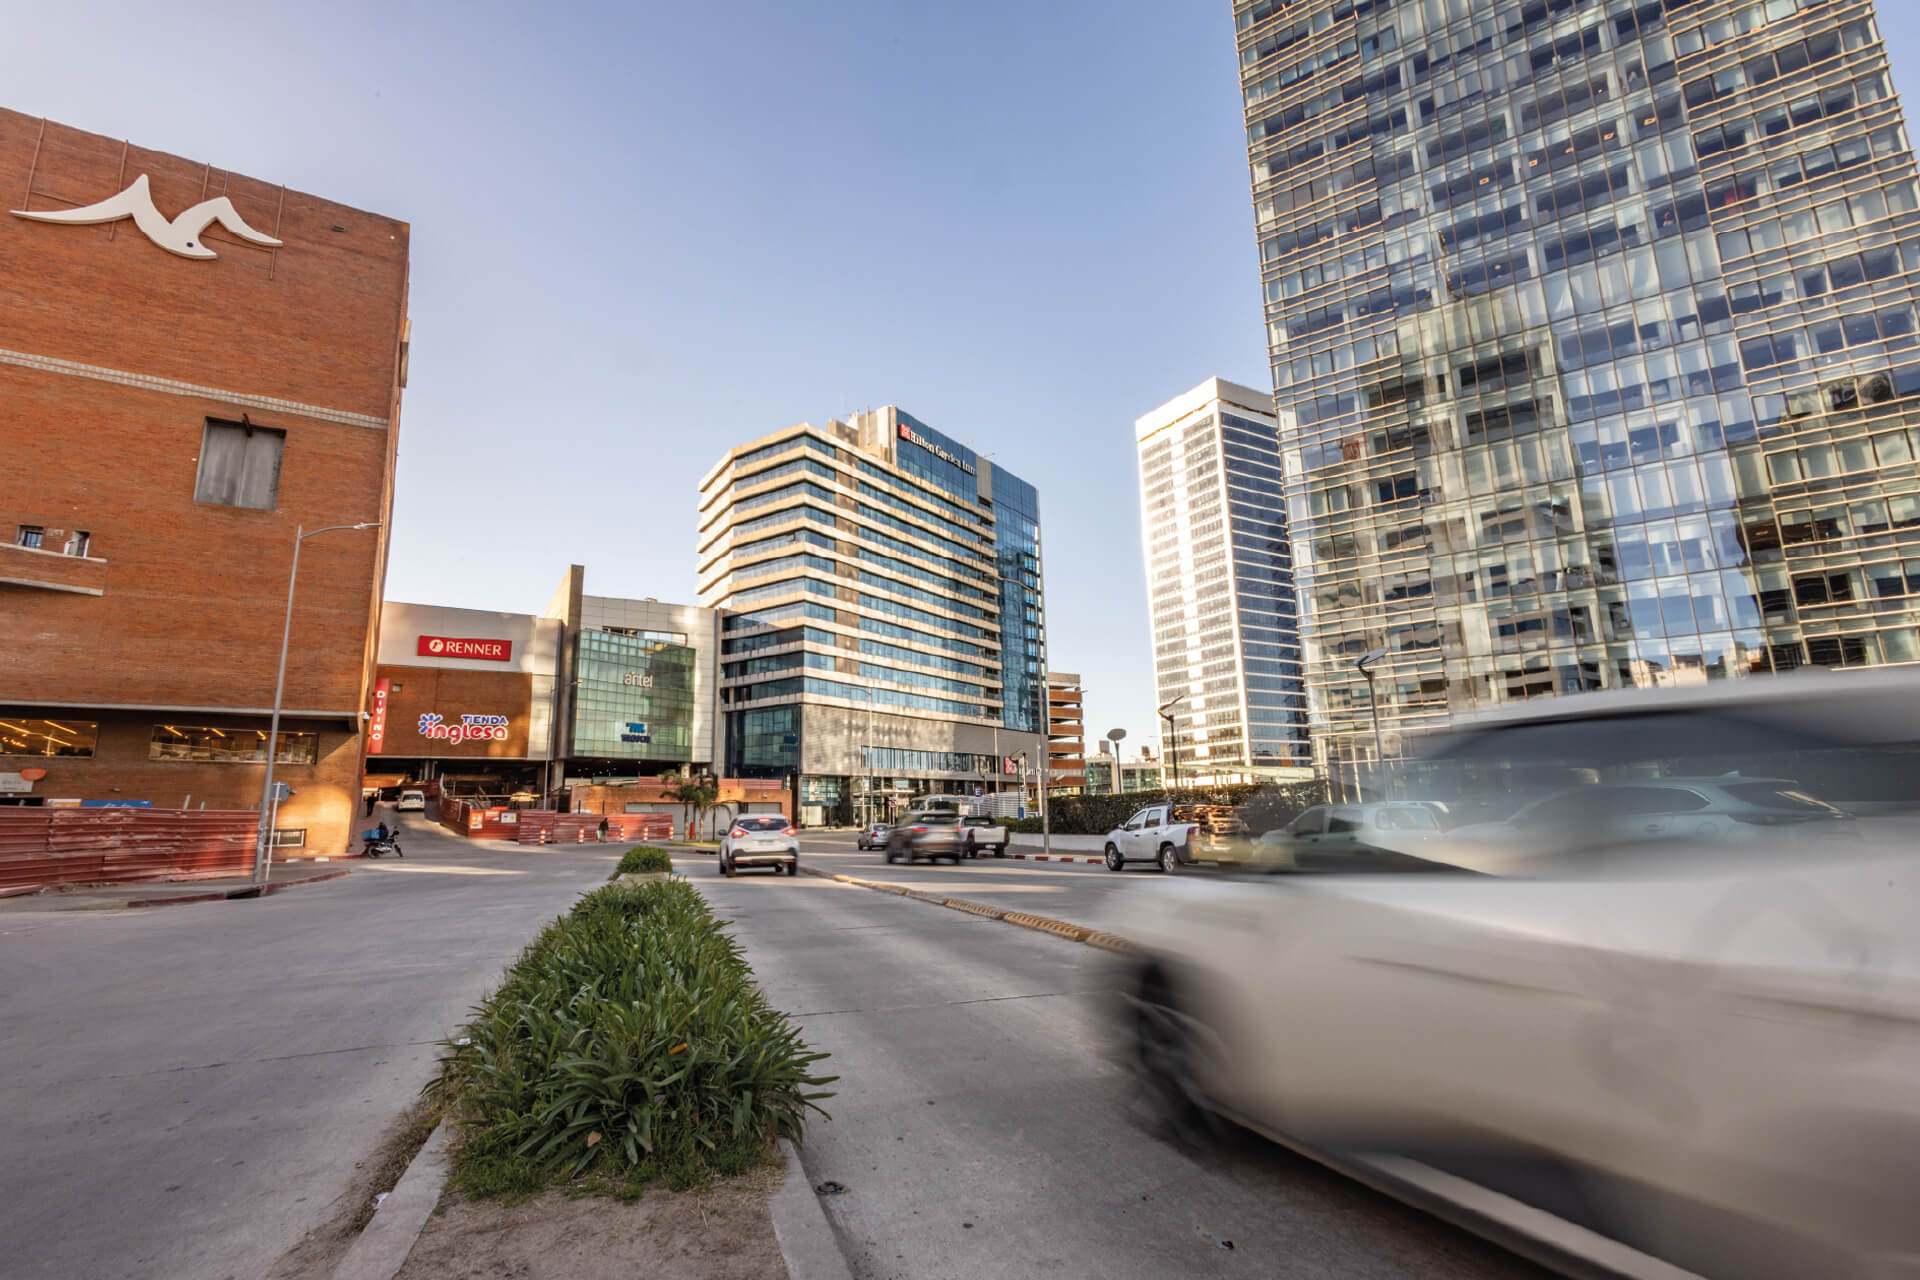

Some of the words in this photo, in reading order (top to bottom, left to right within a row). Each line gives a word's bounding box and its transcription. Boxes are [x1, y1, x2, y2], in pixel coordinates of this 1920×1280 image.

[910, 430, 934, 453] Hilton
[935, 445, 961, 467] Garden
[962, 460, 975, 475] Inn
[446, 641, 501, 656] RENNER
[624, 672, 653, 688] antel
[372, 690, 386, 740] DIVINO
[462, 715, 507, 725] TIENDA
[426, 721, 507, 744] inglesa
